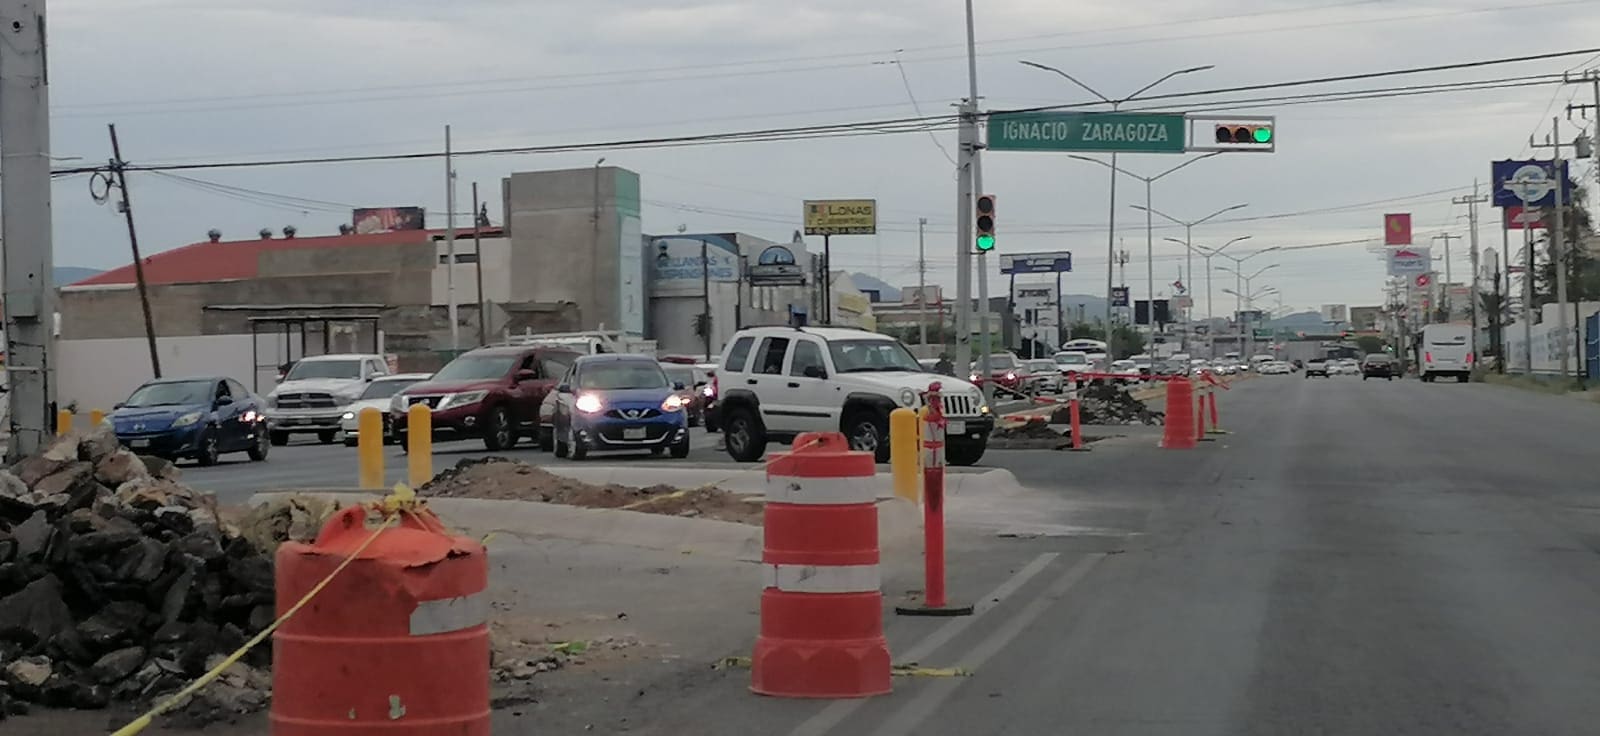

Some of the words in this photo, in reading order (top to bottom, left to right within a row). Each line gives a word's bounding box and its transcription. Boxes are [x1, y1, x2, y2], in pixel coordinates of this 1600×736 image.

[1002, 121, 1067, 141] IGNACIO
[1081, 122, 1168, 142] ZARAGOZA
[828, 205, 872, 216] LONAS
